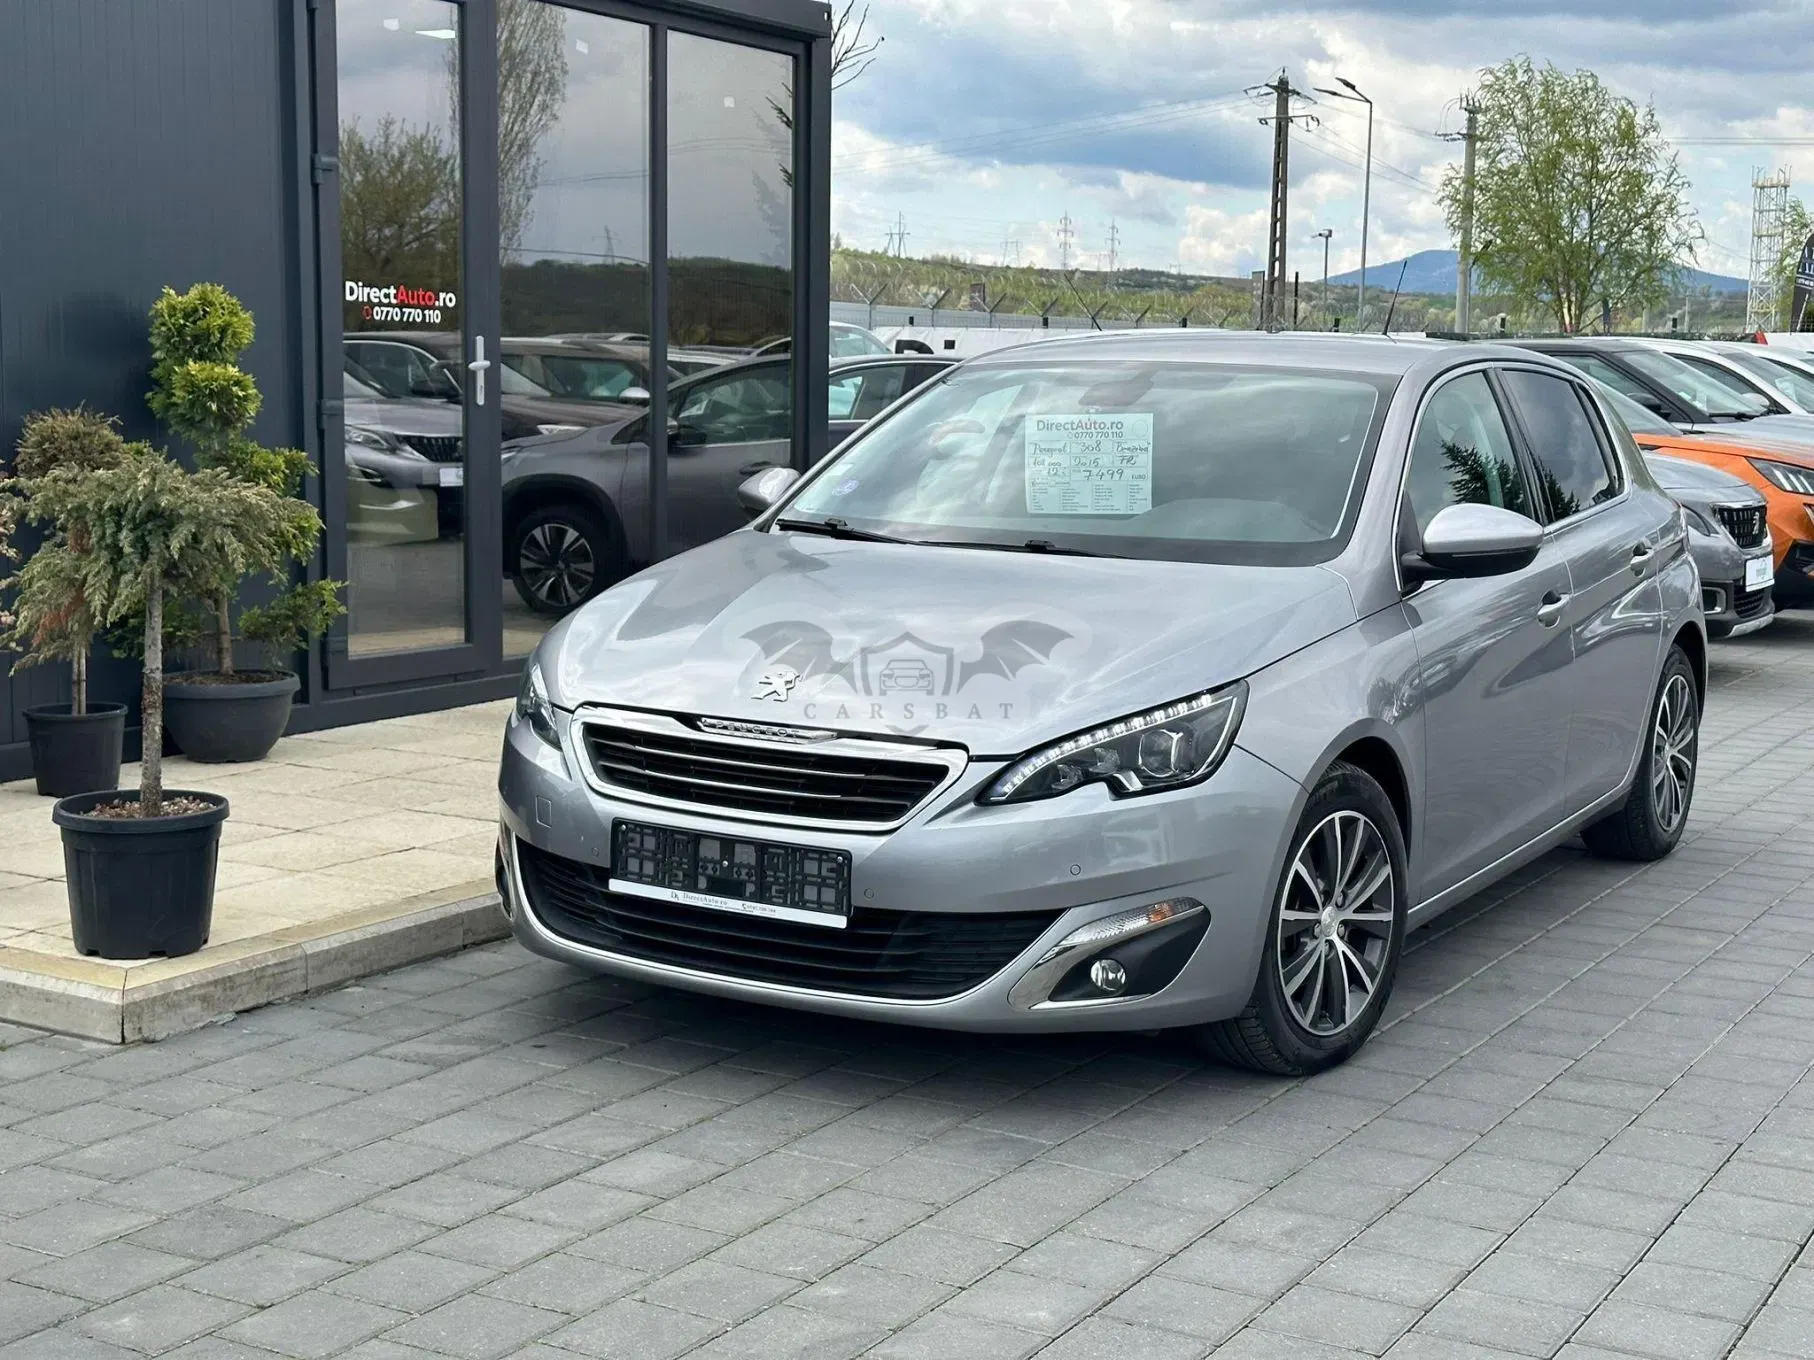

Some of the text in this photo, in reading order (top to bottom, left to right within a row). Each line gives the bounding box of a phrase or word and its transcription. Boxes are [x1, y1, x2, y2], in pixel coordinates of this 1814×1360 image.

[345, 280, 456, 308] DirectAuto.ro
[373, 306, 441, 323] 0770 770 110
[1036, 419, 1124, 431] DirectAuto.ro
[1074, 431, 1124, 439] 0770 770 110
[1080, 440, 1102, 453] 308
[1082, 468, 1124, 480] 7499
